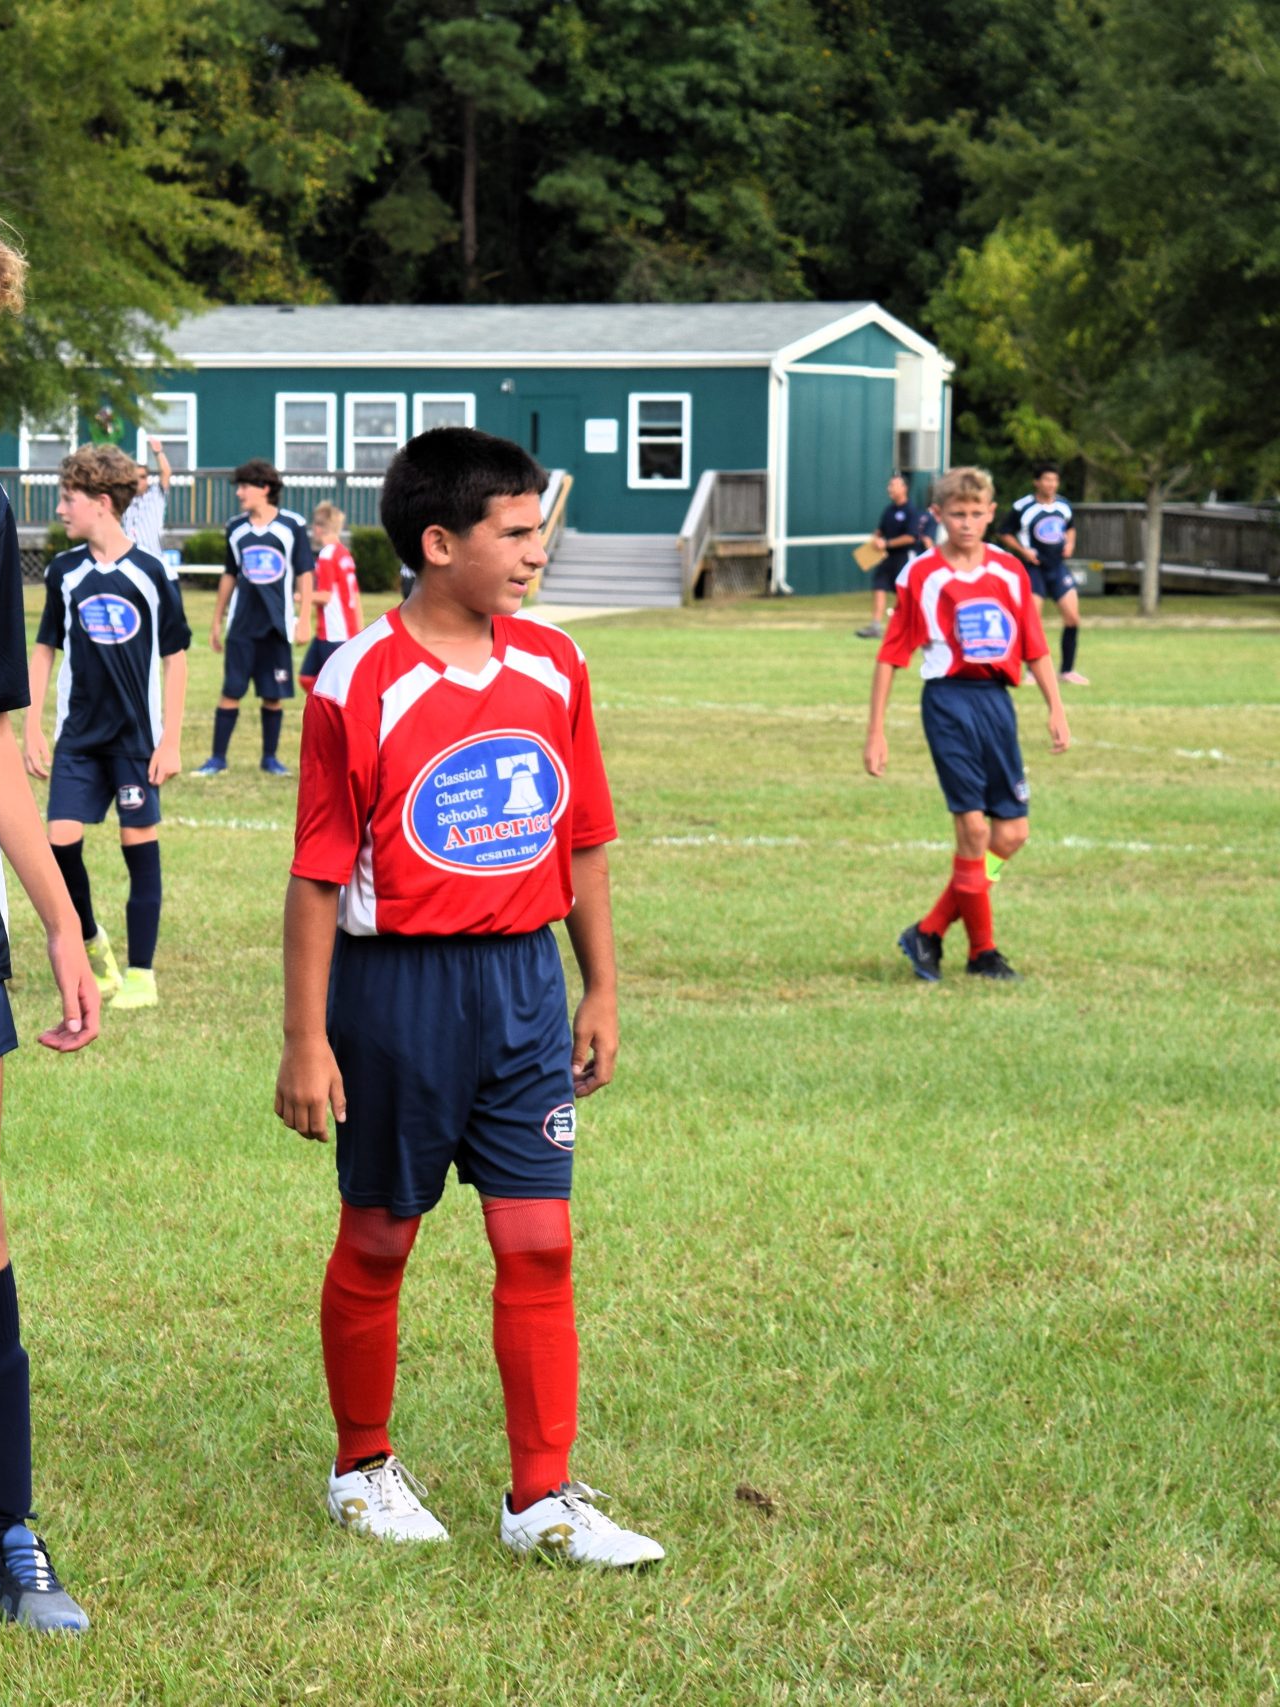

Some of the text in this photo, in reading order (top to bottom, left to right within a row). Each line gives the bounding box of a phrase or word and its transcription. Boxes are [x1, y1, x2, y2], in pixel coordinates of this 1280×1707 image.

[433, 764, 488, 789] Classical
[435, 787, 484, 807] Charter
[437, 804, 489, 827] Schools
[443, 812, 552, 851] America
[476, 843, 539, 864] ccsam.net
